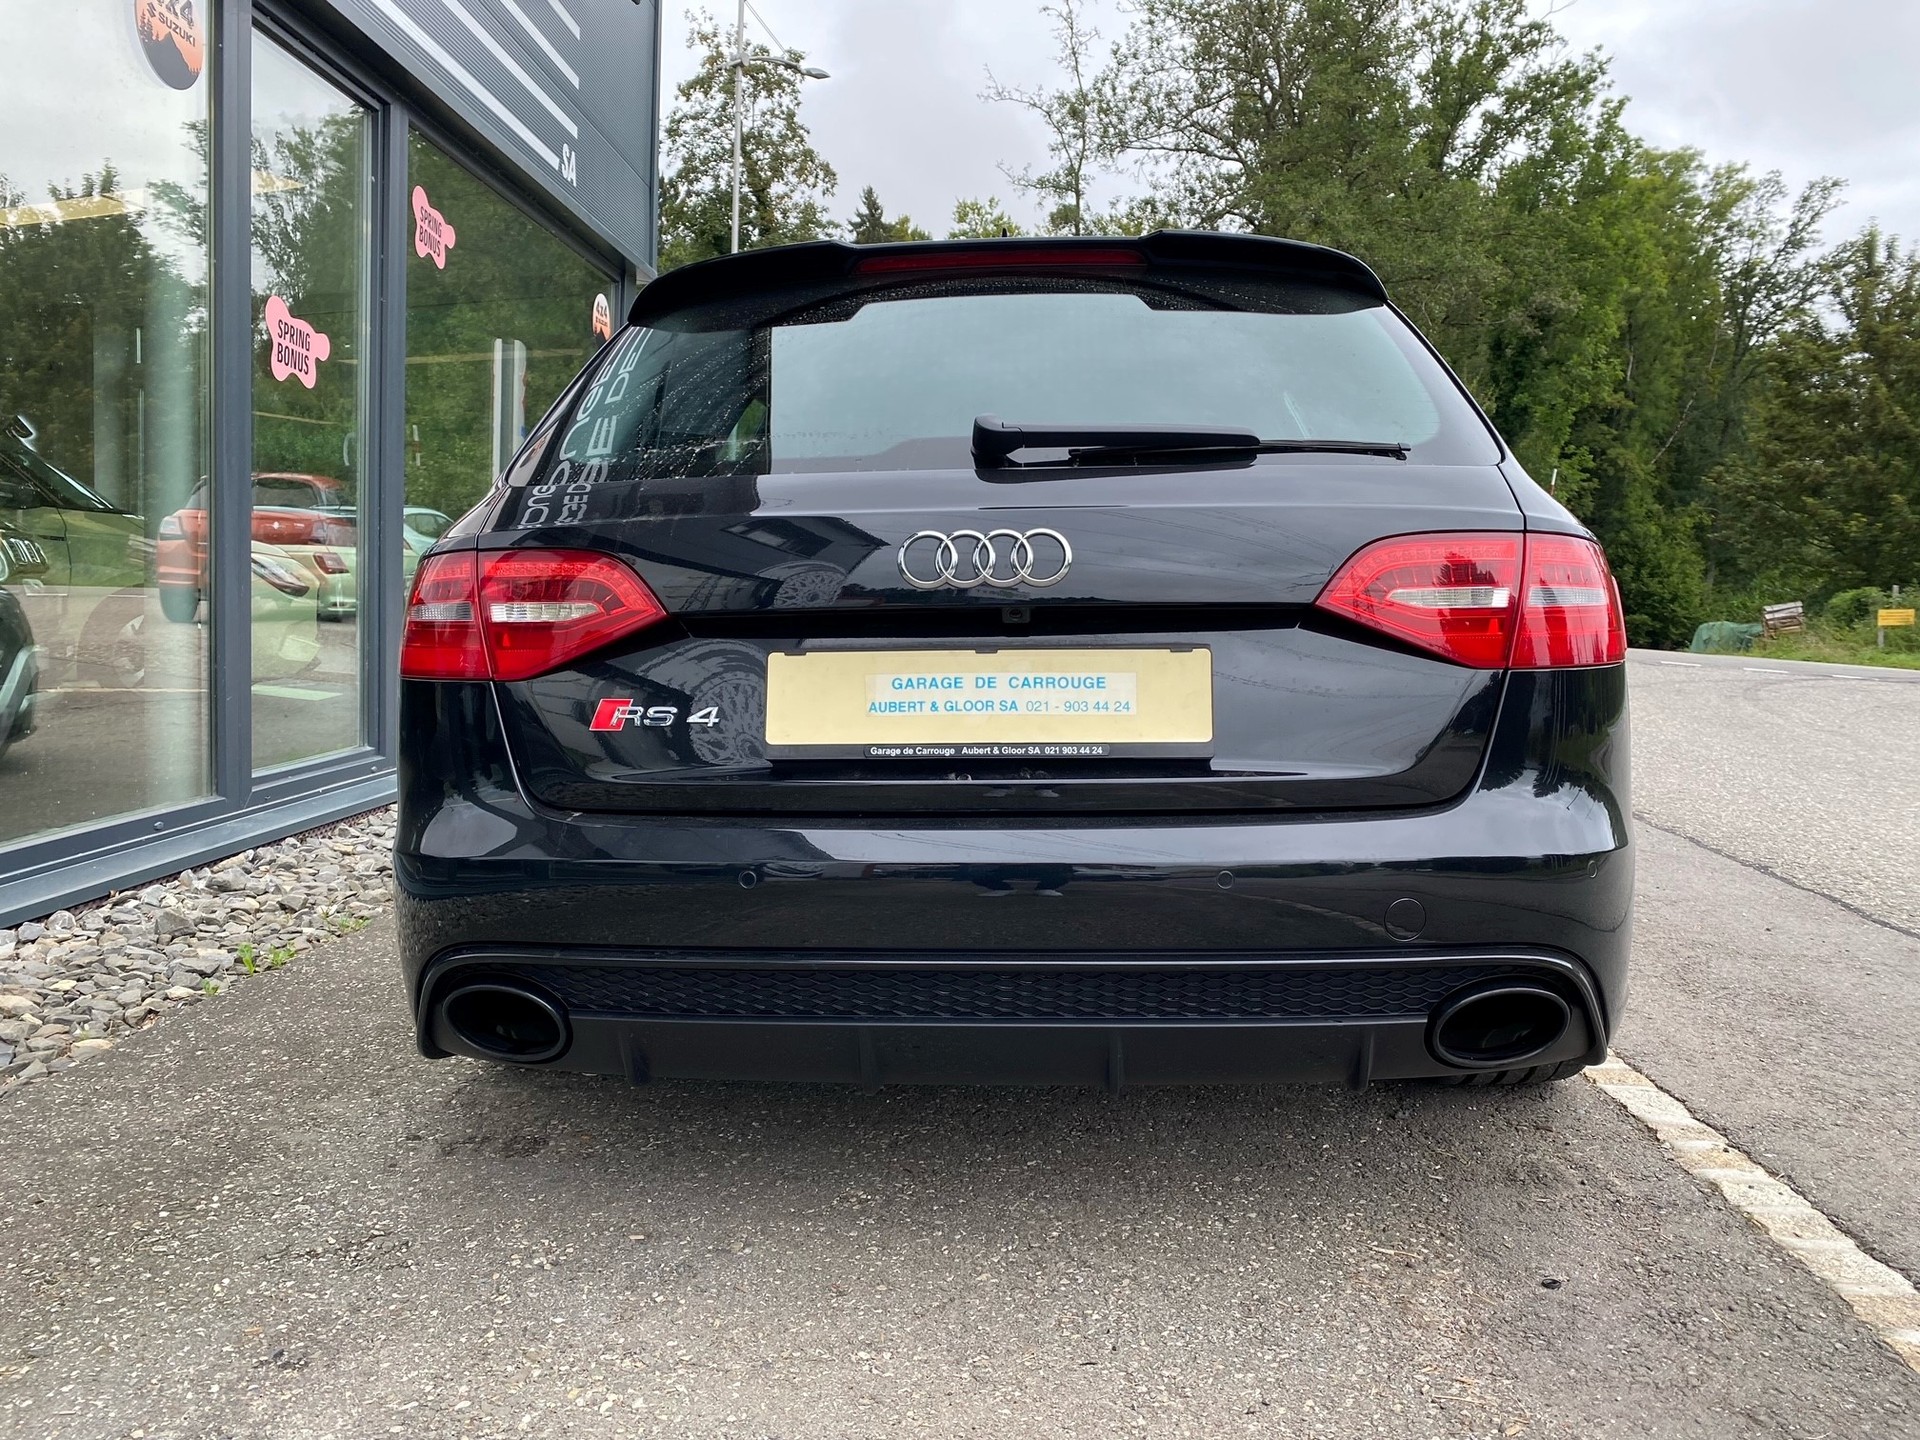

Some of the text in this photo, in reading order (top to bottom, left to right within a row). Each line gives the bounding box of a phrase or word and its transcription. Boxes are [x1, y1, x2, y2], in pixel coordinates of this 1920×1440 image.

[158, 11, 196, 48] SUZUKI
[561, 143, 577, 188] SA
[419, 206, 443, 238] SPRING
[418, 227, 441, 257] BONUS
[277, 319, 311, 352] SPRING
[277, 342, 310, 376] BONUS
[891, 676, 1106, 690] GARAGE DE CARROUGE
[610, 706, 721, 727] RS 4
[868, 701, 926, 713] AUBERT
[930, 701, 939, 712] &
[944, 700, 995, 712] GLOOR
[999, 700, 1019, 712] SA
[1025, 701, 1049, 712] 021
[1064, 701, 1089, 712] 903
[1092, 701, 1109, 712] 44
[1114, 701, 1131, 712] 24
[870, 746, 1103, 757] Garage de Carrouge Aubert & Gloor SA 021 903 44 24
